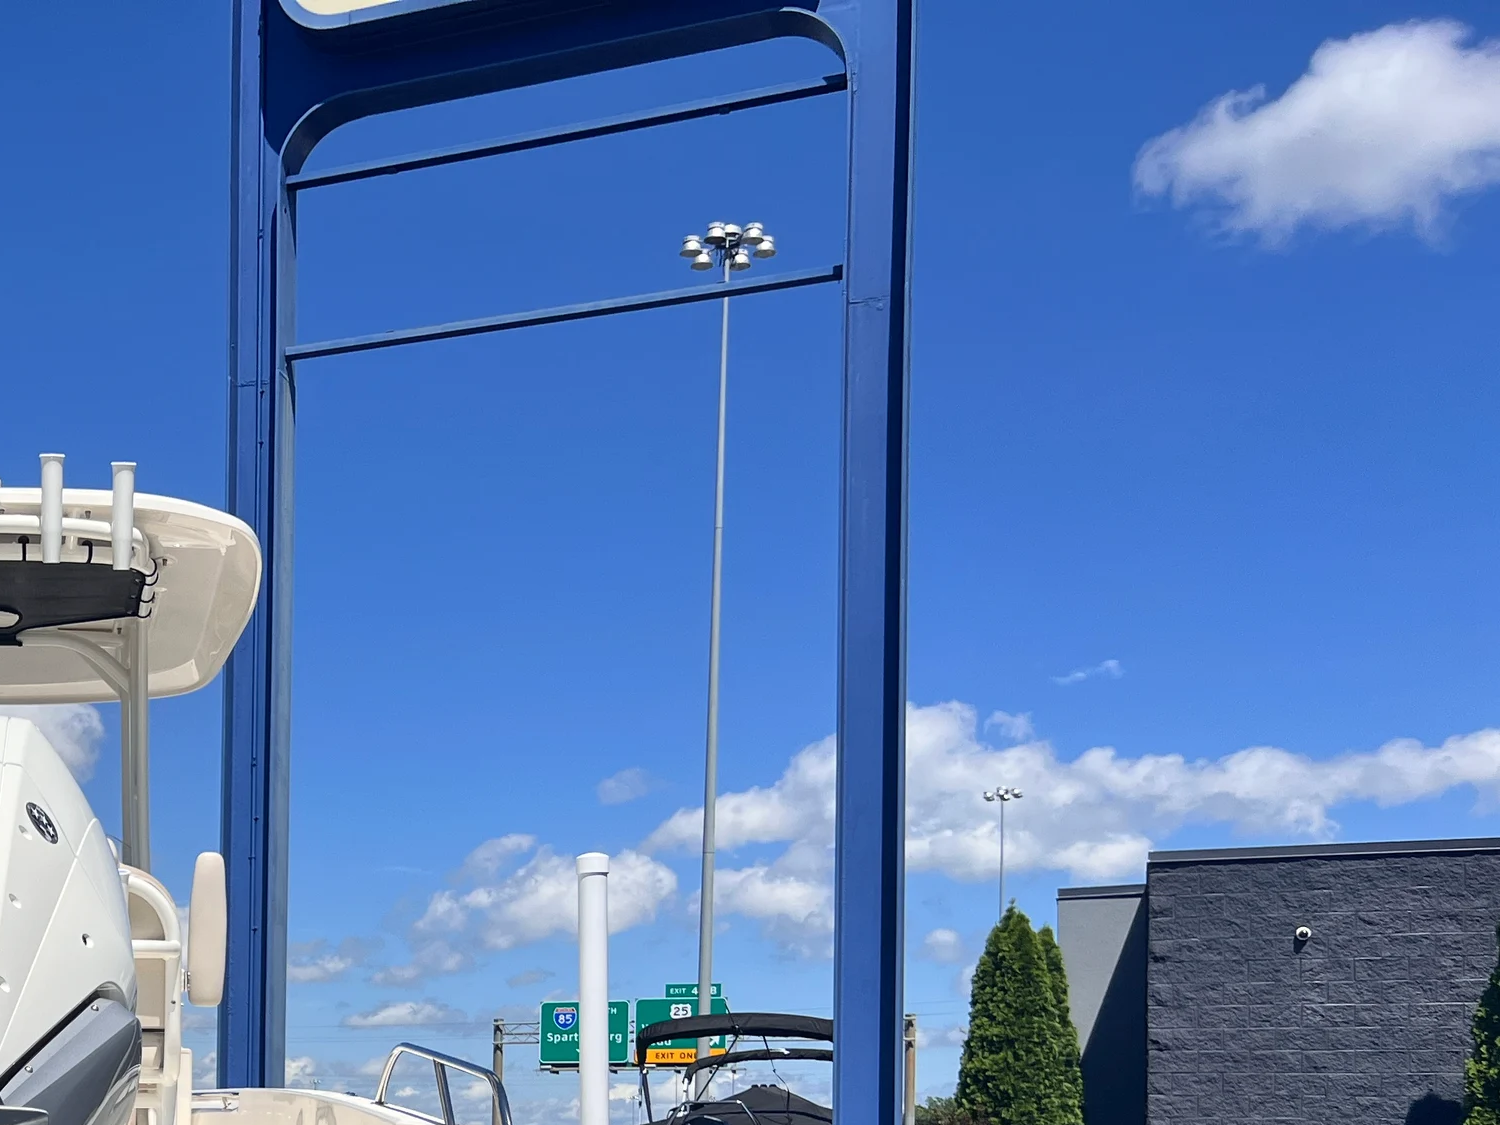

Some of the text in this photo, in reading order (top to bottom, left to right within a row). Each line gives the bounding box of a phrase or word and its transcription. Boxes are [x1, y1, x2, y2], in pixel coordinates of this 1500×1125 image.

[670, 986, 717, 995] EXIT 4B
[673, 1006, 689, 1016] 25
[558, 1014, 573, 1024] 85
[546, 1032, 622, 1044] Spartrg
[655, 1052, 674, 1060] EXIT
